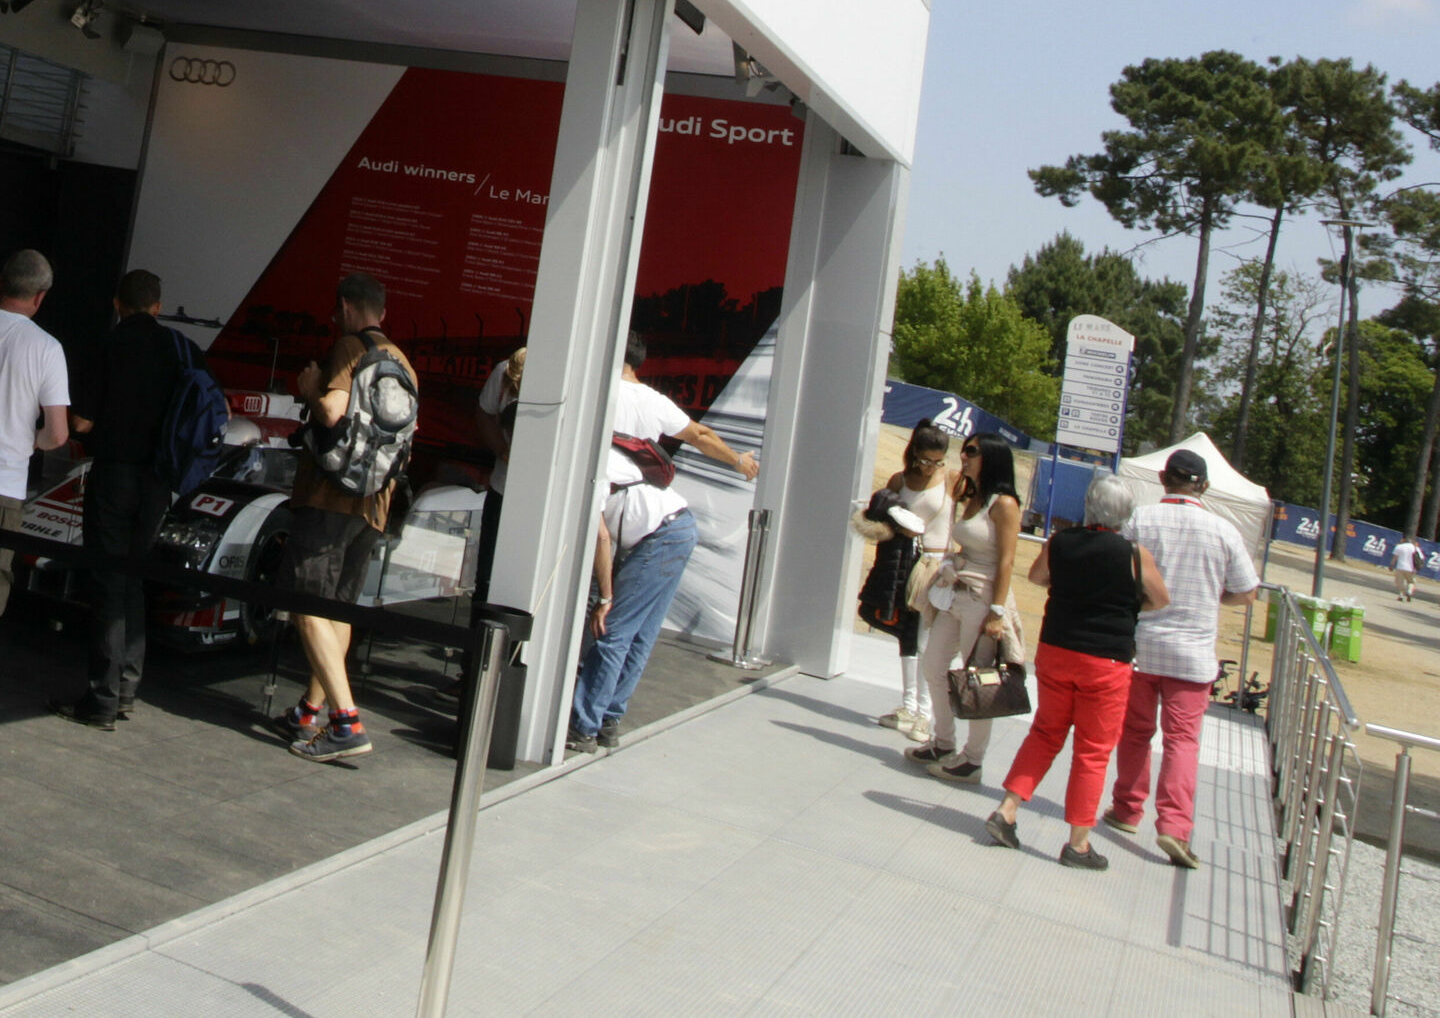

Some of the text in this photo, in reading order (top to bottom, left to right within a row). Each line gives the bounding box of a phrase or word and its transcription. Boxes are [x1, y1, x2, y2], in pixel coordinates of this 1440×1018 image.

[658, 116, 795, 146] udi Sport
[357, 156, 477, 184] Audi winners
[489, 185, 510, 200] Le
[1088, 336, 1123, 346] CHAPELLE
[932, 396, 973, 437] 24h
[195, 495, 225, 512] P1
[1363, 535, 1387, 552] 24h
